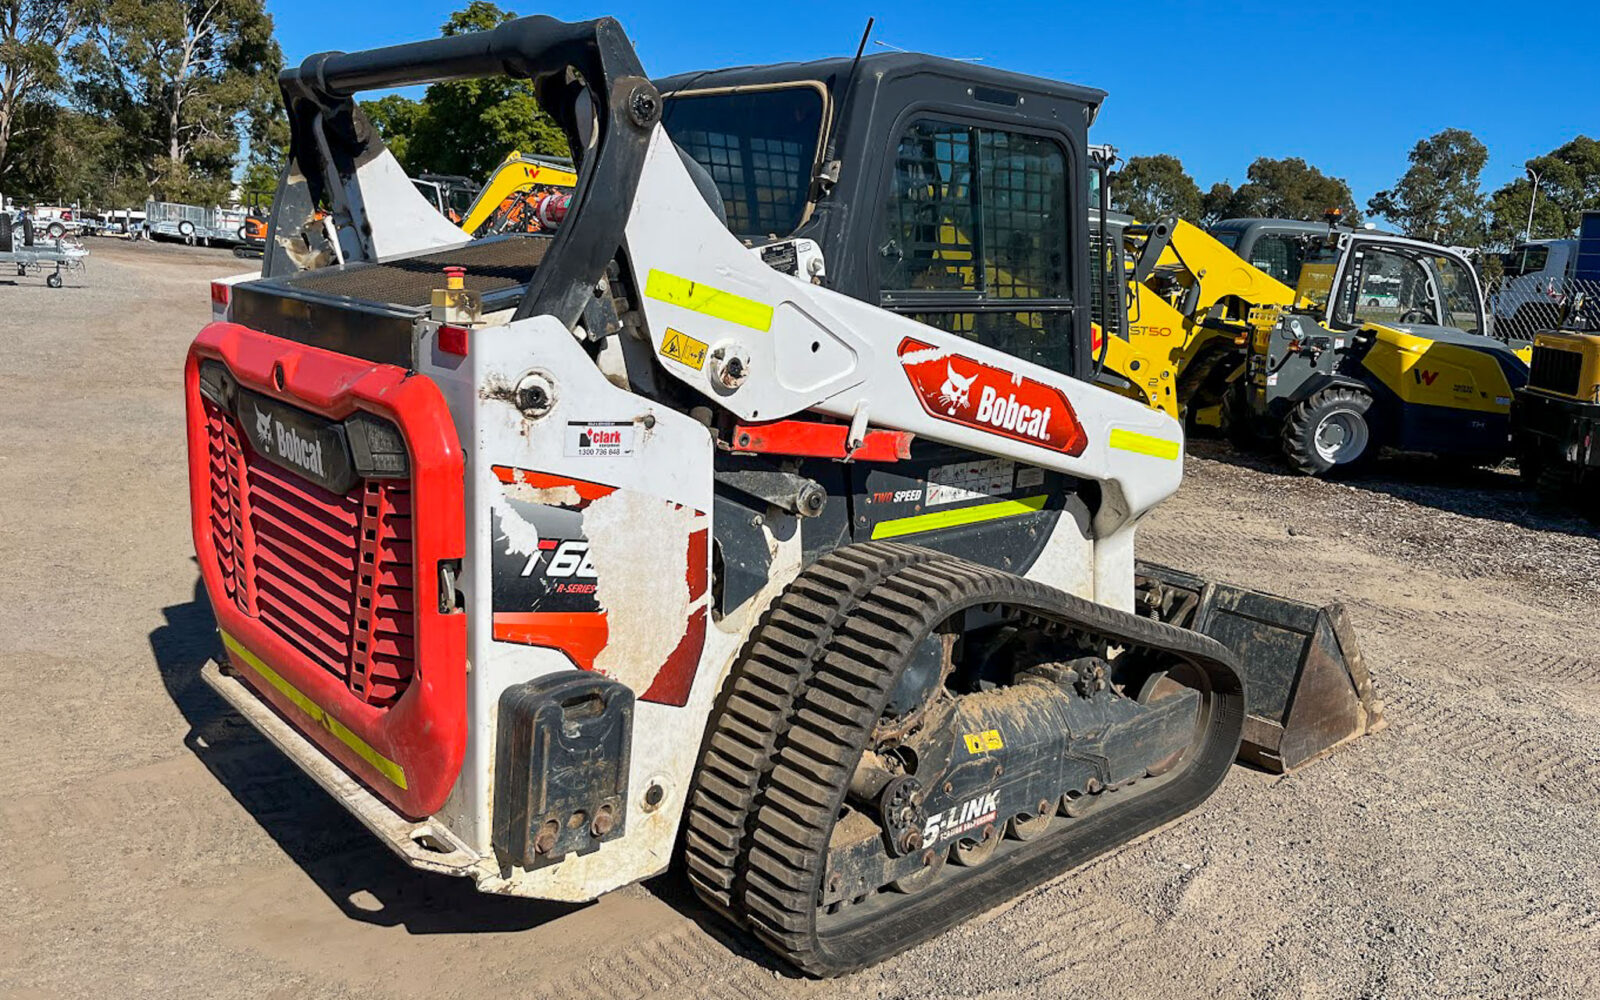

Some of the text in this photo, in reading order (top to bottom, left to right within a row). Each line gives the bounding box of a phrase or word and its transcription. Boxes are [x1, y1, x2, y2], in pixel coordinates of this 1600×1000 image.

[1130, 326, 1172, 337] ST50
[975, 385, 1051, 441] Bobcat
[593, 430, 621, 444] clark
[275, 420, 325, 478] Bobcat
[873, 489, 922, 504] TWO SPEED
[556, 583, 597, 594] R-SERIES
[921, 789, 1001, 850] 5-LINK
